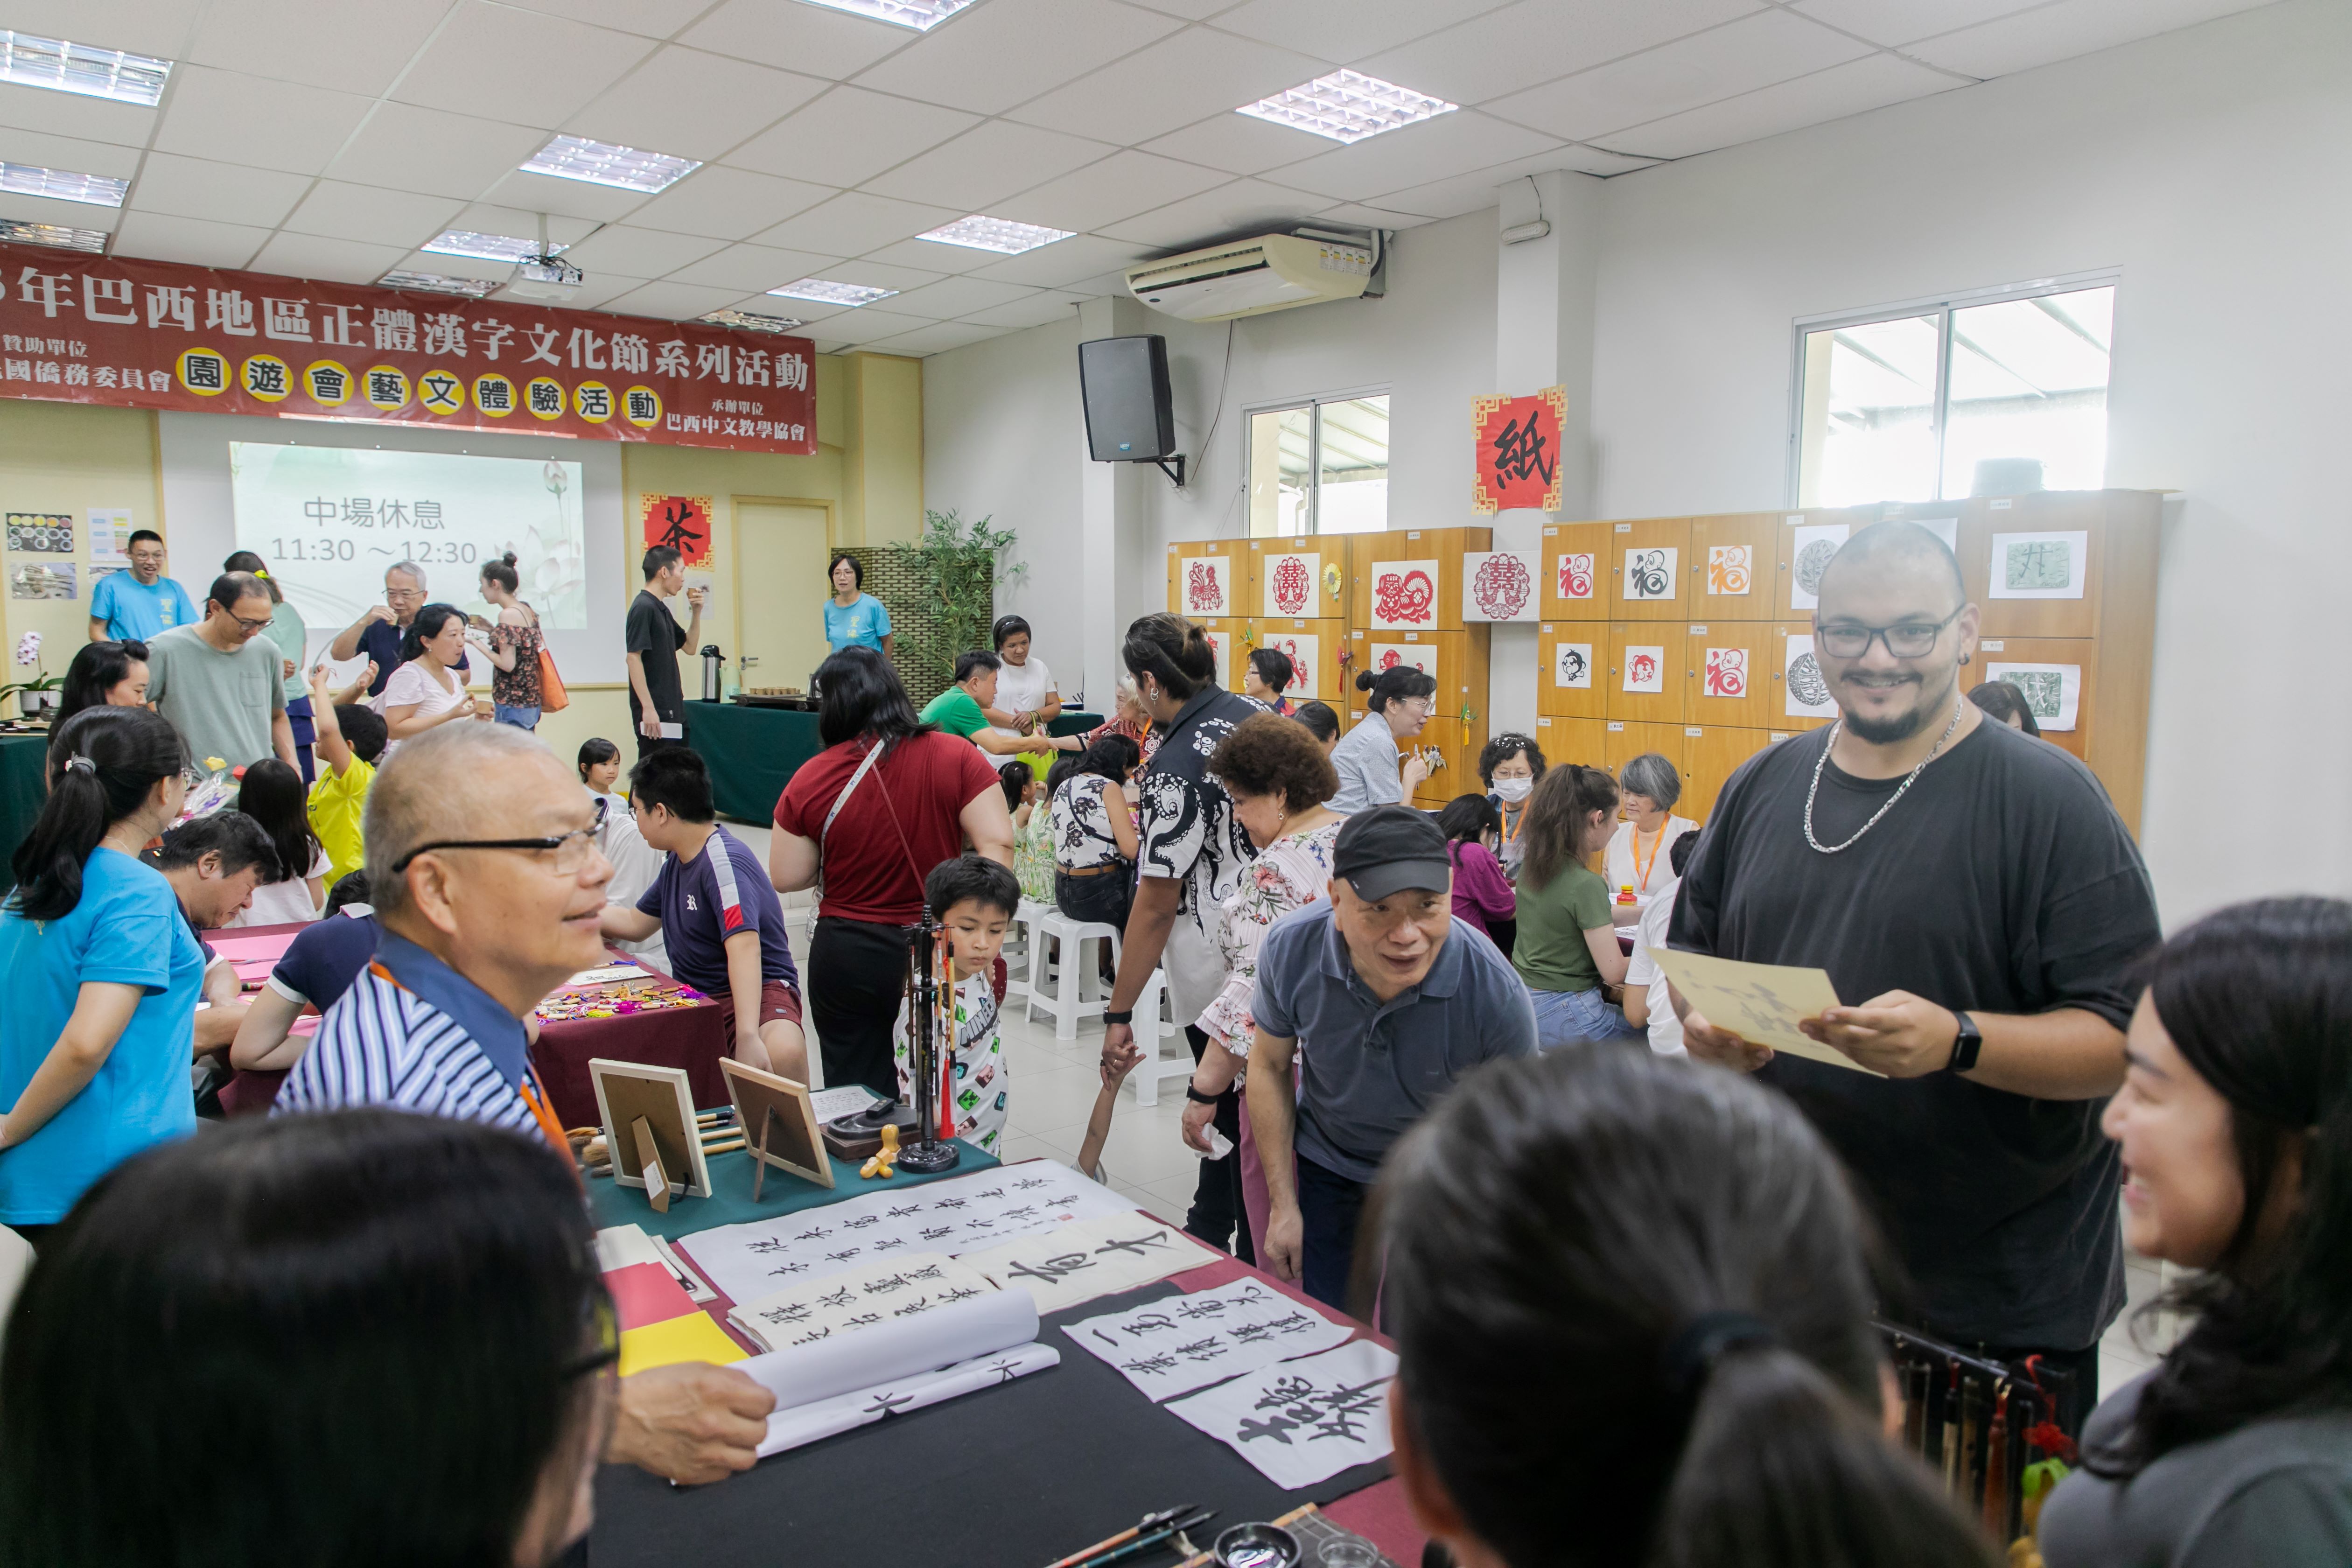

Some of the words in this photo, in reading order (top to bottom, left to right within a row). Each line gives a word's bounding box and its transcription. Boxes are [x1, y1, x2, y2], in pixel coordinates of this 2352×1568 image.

[3, 334, 88, 357] 贊助單位
[0, 358, 171, 392] 國僑務委員會
[187, 356, 657, 419] 園遊會藝文體驗活動
[712, 399, 763, 416] 承辦單位
[667, 413, 806, 441] 巴西中文教學協會
[1494, 410, 1554, 490] 紙
[304, 496, 445, 530] 中場休息
[659, 502, 703, 553] 茶
[272, 538, 355, 562] 11:30
